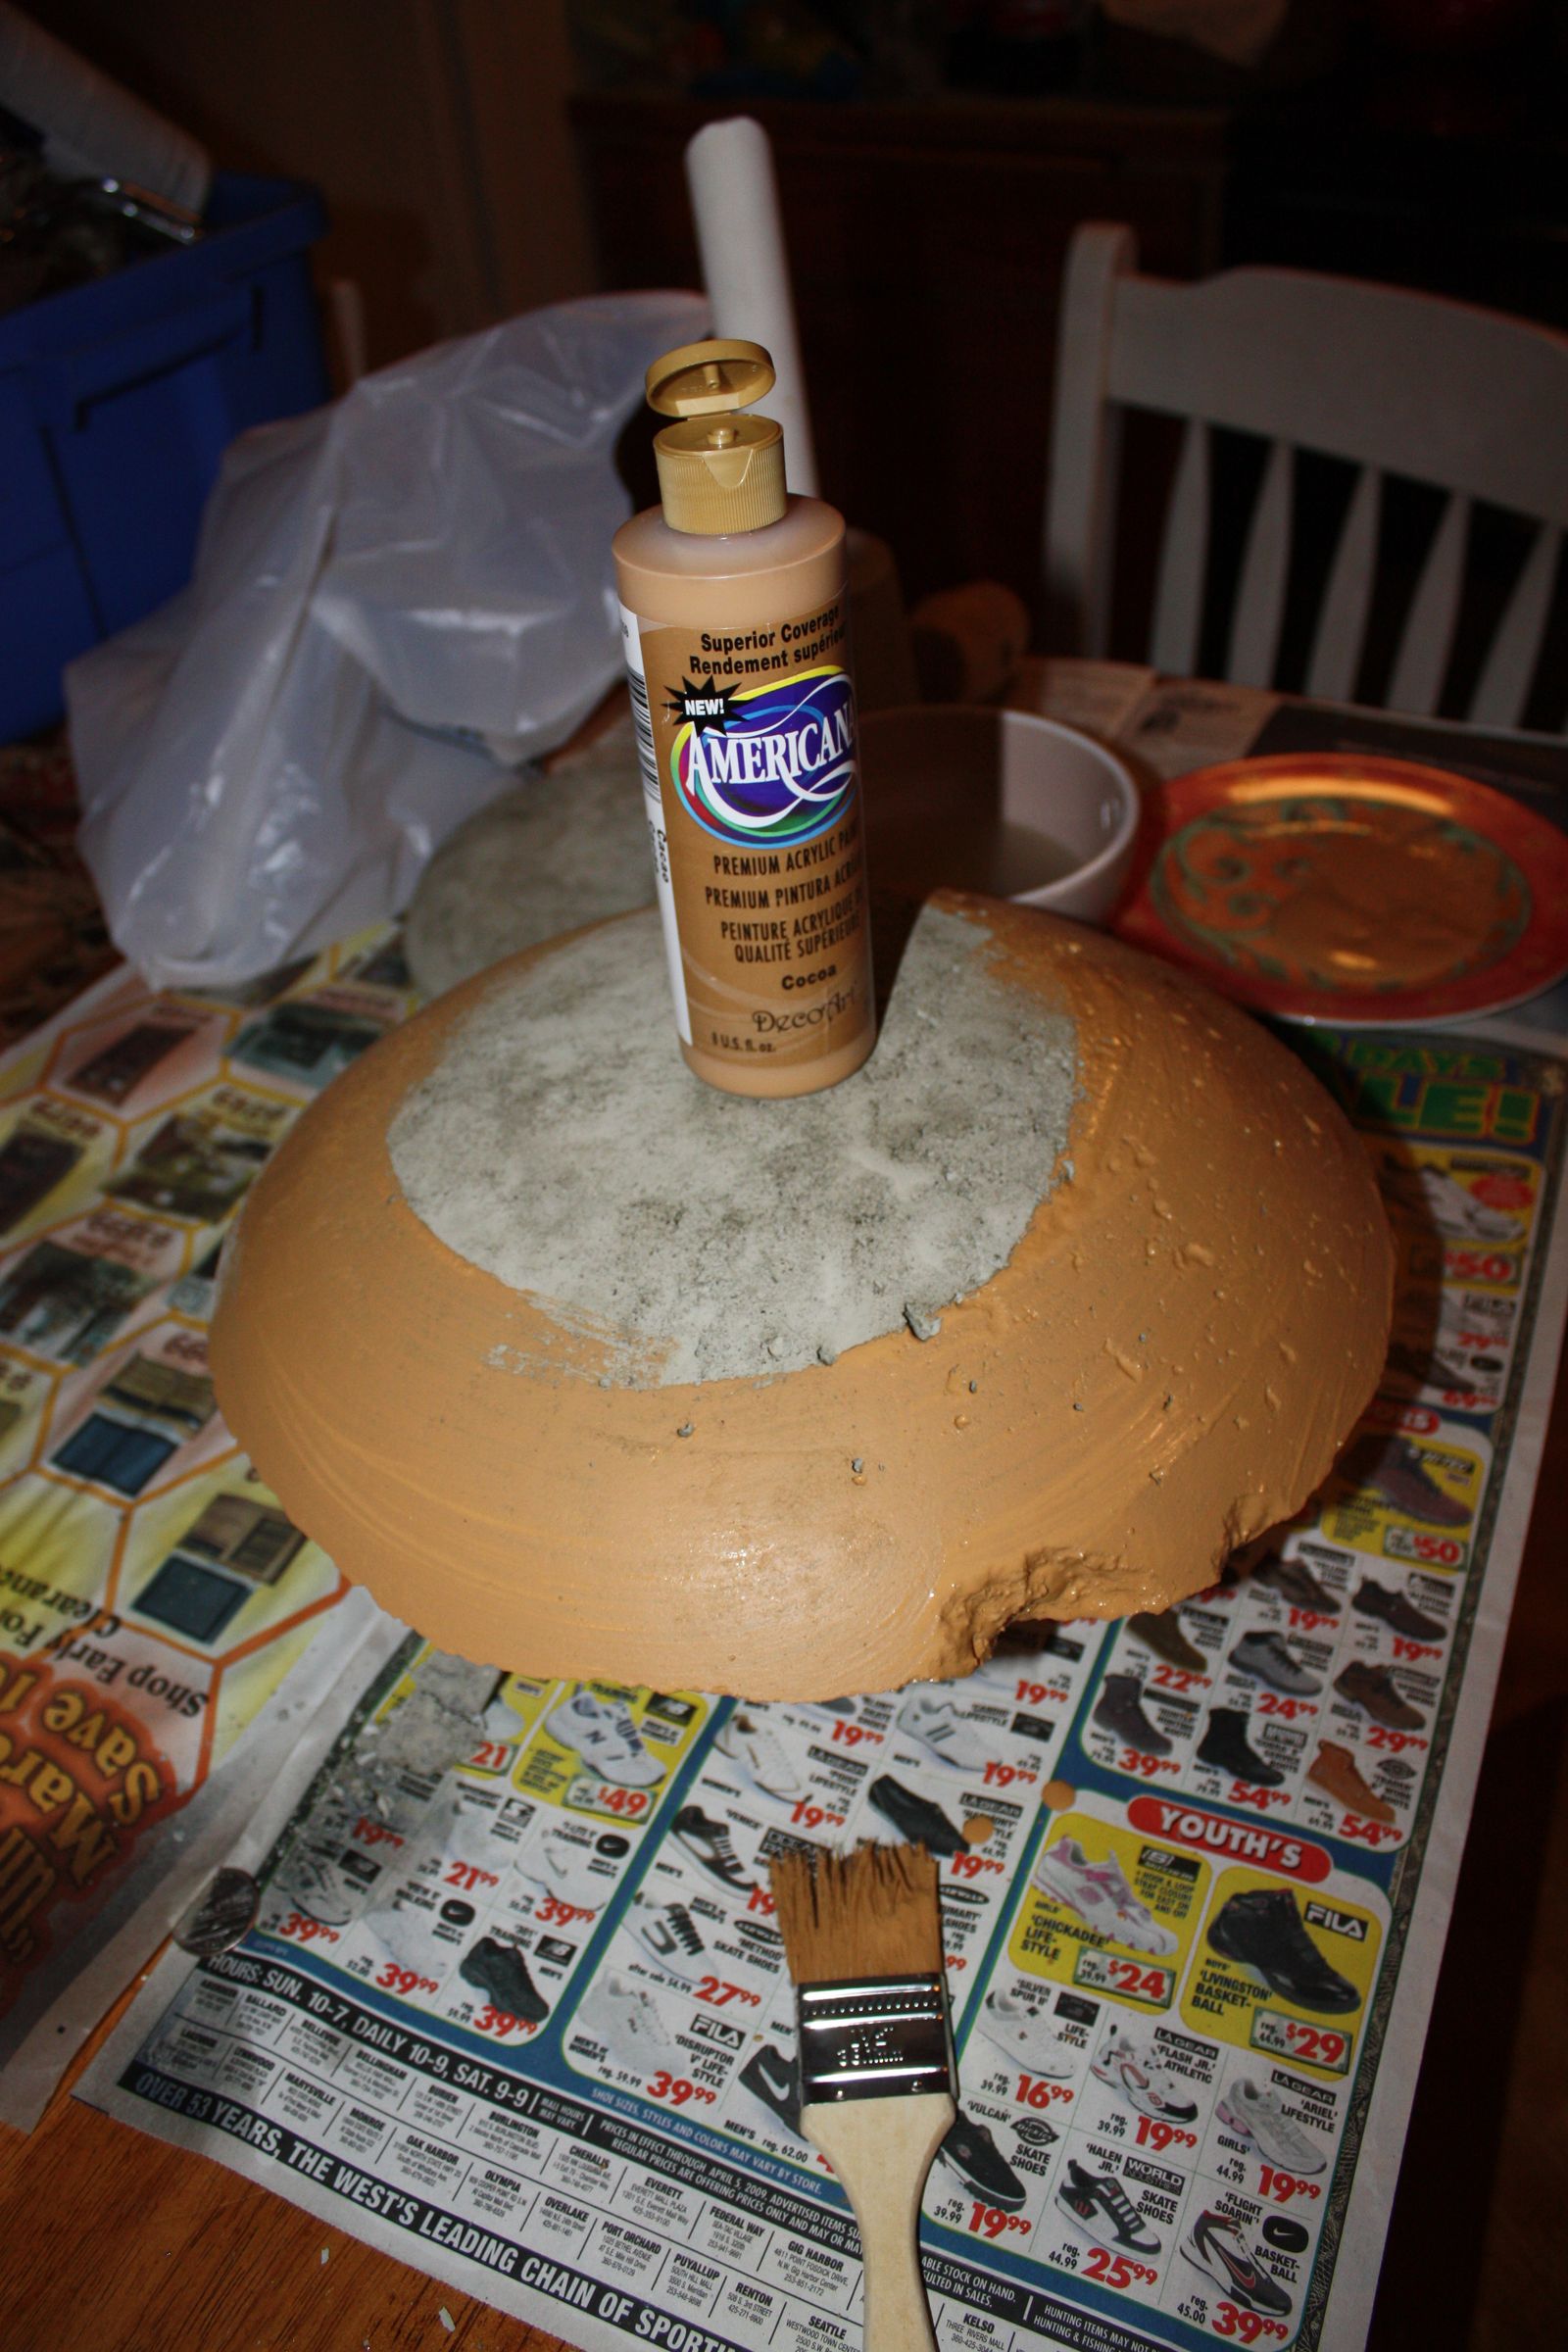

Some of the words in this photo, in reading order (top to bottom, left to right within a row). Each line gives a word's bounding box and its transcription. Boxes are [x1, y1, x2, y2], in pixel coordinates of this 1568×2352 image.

[701, 632, 775, 656] Superior
[781, 605, 840, 643] Coverage
[689, 650, 789, 675] Rendement
[684, 698, 725, 716] NEW!
[686, 698, 855, 796] AMERICAN
[713, 855, 780, 876] PREMIUM
[786, 836, 836, 872] ACRYLIC
[705, 886, 770, 909] PREMIUM
[775, 875, 831, 906] PINTURA
[720, 919, 787, 941] PEINTURE
[793, 893, 853, 937] ACRYLIQUE
[734, 937, 793, 963] QUALITÉ
[781, 963, 838, 990] Cocoa
[45, 1623, 123, 1685] Early
[129, 1664, 209, 1719] Shop
[41, 1690, 163, 1828] Save
[1158, 1804, 1303, 1870] YOUTH'S
[1306, 1901, 1364, 1939] FILA
[1025, 1927, 1058, 1944] LIFE-
[1020, 1938, 1061, 1961] STYLE
[1107, 1959, 1166, 2001] $24
[1191, 1995, 1225, 2016] BALL
[1195, 1981, 1251, 2008] BASKET-
[207, 1954, 264, 1984] HOURS:
[263, 1969, 301, 2001] SUN.
[307, 1991, 349, 2029] 10-7,
[352, 2015, 409, 2054] DAILY
[408, 2042, 450, 2079] 10-9,
[453, 2063, 493, 2094] SAT.
[494, 2080, 530, 2108] 9-9
[692, 2016, 744, 2048] FILA
[1258, 2033, 1287, 2048] 44.99
[1286, 2022, 1345, 2065] $29
[1156, 2044, 1194, 2067] 'FLASH
[690, 2067, 724, 2089] STYLE
[993, 2072, 1011, 2086] reg.
[1163, 2059, 1213, 2085] ATHLETIC
[980, 2079, 1008, 2097] 39.99
[1097, 2120, 1127, 2138] 39.99
[1109, 2112, 1129, 2126] reg.
[1281, 2103, 1336, 2134] LIFESTYLE
[643, 2107, 672, 2130] STYLES
[672, 2121, 694, 2138] AND
[694, 2130, 730, 2152] COLORS
[732, 2145, 752, 2163] MAY
[752, 2154, 776, 2175] VARY
[776, 2166, 790, 2180] BY
[790, 2172, 822, 2196] STORE.
[723, 2119, 758, 2141] MEN'S
[760, 2136, 780, 2156] reg.
[780, 2143, 809, 2164] 62.00
[1015, 2143, 1052, 2165] SKATE
[1086, 2142, 1123, 2164] 'HALEN
[1216, 2134, 1251, 2156] GIRLS'
[600, 2119, 628, 2139] PRICES
[638, 2134, 666, 2154] EFFECT
[666, 2146, 709, 2173] THROUGH
[709, 2167, 734, 2187] APRIL
[744, 2182, 769, 2200] 2009.
[769, 2193, 821, 2224] ADVERTISED
[821, 2216, 848, 2234] ITEMS
[1009, 2155, 1048, 2178] SHOES
[1126, 2158, 1182, 2186] WORLD
[1215, 2164, 1245, 2184] 44.99
[1228, 2157, 1248, 2173] reg.
[484, 2169, 522, 2194] OLYMPIA
[612, 2138, 650, 2163] REGULAR
[649, 2156, 677, 2175] PRICES
[677, 2167, 695, 2182] ARE
[694, 2175, 736, 2199] OFFERING
[736, 2192, 765, 2213] PRICES
[764, 2205, 789, 2224] ONLY
[788, 2216, 808, 2231] AND
[808, 2225, 829, 2241] MAY
[829, 2232, 844, 2246] OR
[644, 2176, 685, 2201] EVERETT
[212, 2100, 282, 2161] YEARS,
[286, 2140, 334, 2182] THE
[333, 2162, 419, 2227] WEST'S
[418, 2208, 519, 2274] LEADING
[519, 2257, 600, 2313] CHAIN
[599, 2291, 638, 2325] OF
[544, 2195, 590, 2224] OVERLAKE
[948, 2198, 965, 2213] reg.
[1136, 2200, 1175, 2226] SHOES
[1141, 2189, 1178, 2212] SKATE
[1225, 2191, 1263, 2217] 'FLIGHT
[709, 2206, 747, 2233] FEDERAL
[746, 2220, 766, 2238] WAY
[933, 2206, 962, 2225] 39.99
[601, 2220, 624, 2238] PORT
[623, 2230, 662, 2255] ORCHARD
[1062, 2242, 1080, 2259] reg.
[673, 2252, 721, 2281] PUYALLUP
[788, 2239, 806, 2254] GIG
[806, 2246, 845, 2273] HARBOR
[1049, 2251, 1078, 2271] 44.99
[1254, 2245, 1300, 2271] BASKET-
[943, 2262, 971, 2285] STOCK
[971, 2274, 988, 2289] ON
[988, 2278, 1017, 2304] HAND.
[1270, 2264, 1298, 2284] BALL
[735, 2280, 774, 2308] RENTON
[964, 2286, 993, 2309] SALES.
[1191, 2294, 1208, 2311] reg.
[962, 2312, 996, 2334] KELSO
[1044, 2304, 1083, 2328] HUNTING
[1083, 2318, 1109, 2340] ITEMS
[1109, 2328, 1130, 2346] MAY
[1177, 2302, 1206, 2325] 45.00
[808, 2314, 849, 2340] SEATTLE
[1033, 2315, 1071, 2339] HUNTING
